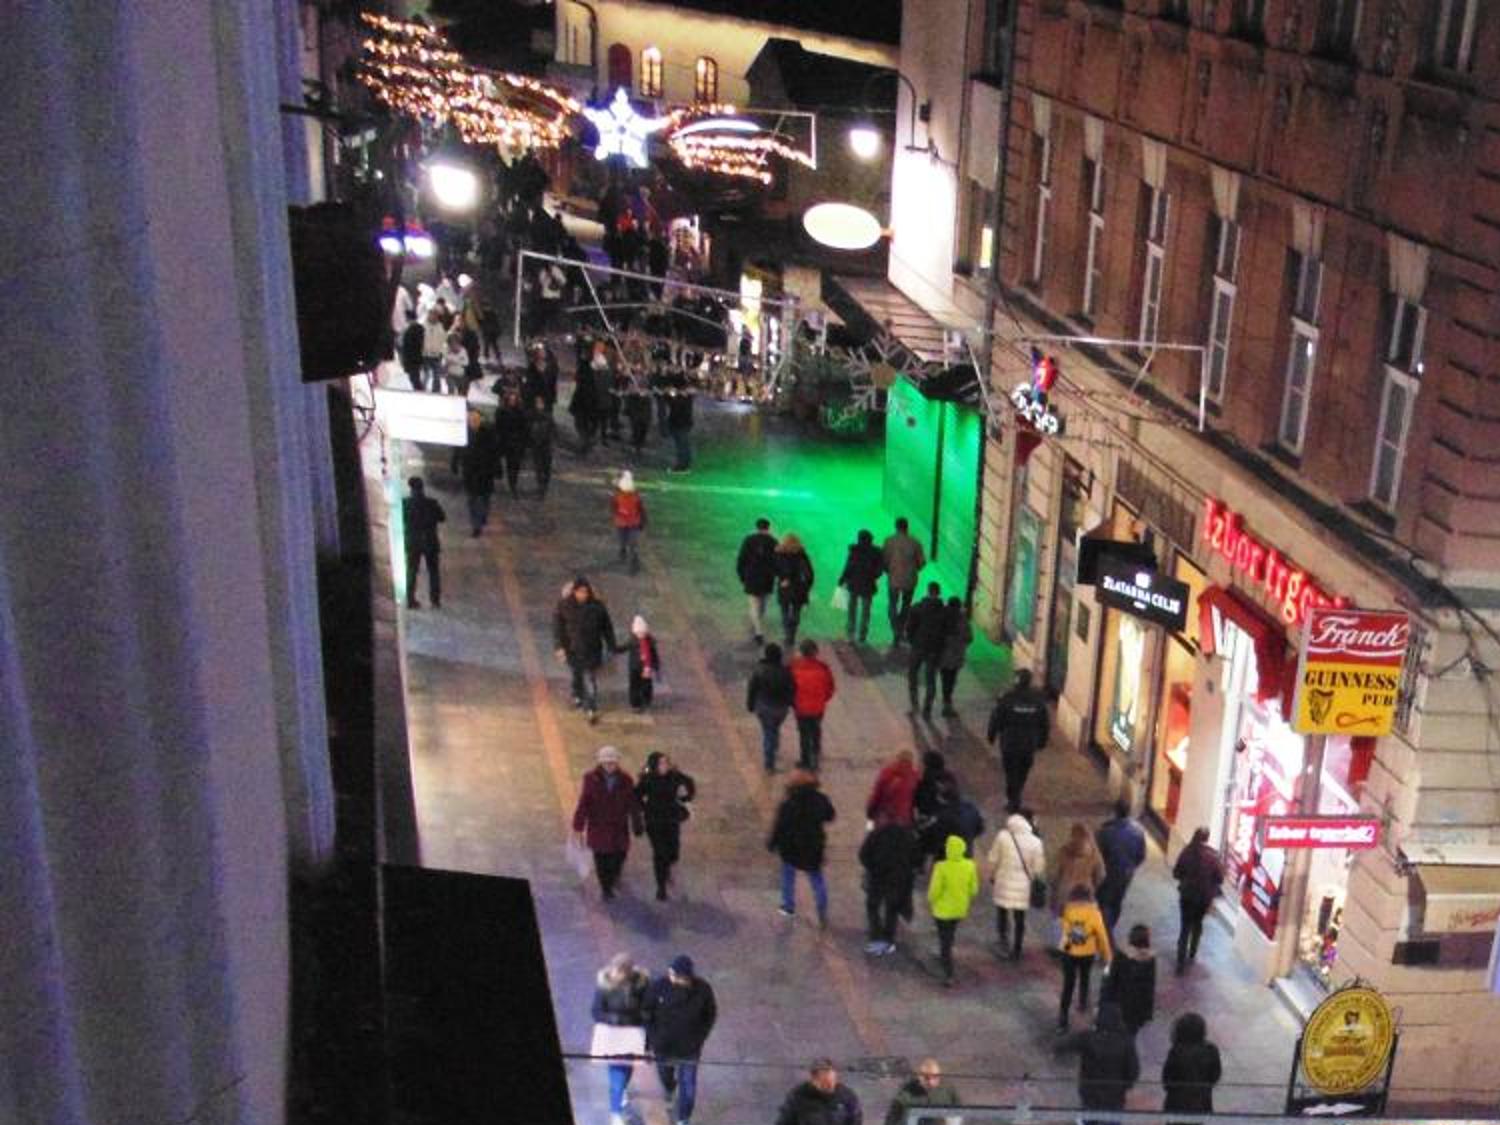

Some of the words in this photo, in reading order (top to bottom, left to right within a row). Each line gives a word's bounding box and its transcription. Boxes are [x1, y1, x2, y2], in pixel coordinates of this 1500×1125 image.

[1310, 615, 1409, 650] Franck
[1304, 670, 1398, 690] GUINNESS
[1361, 693, 1394, 707] PUB
